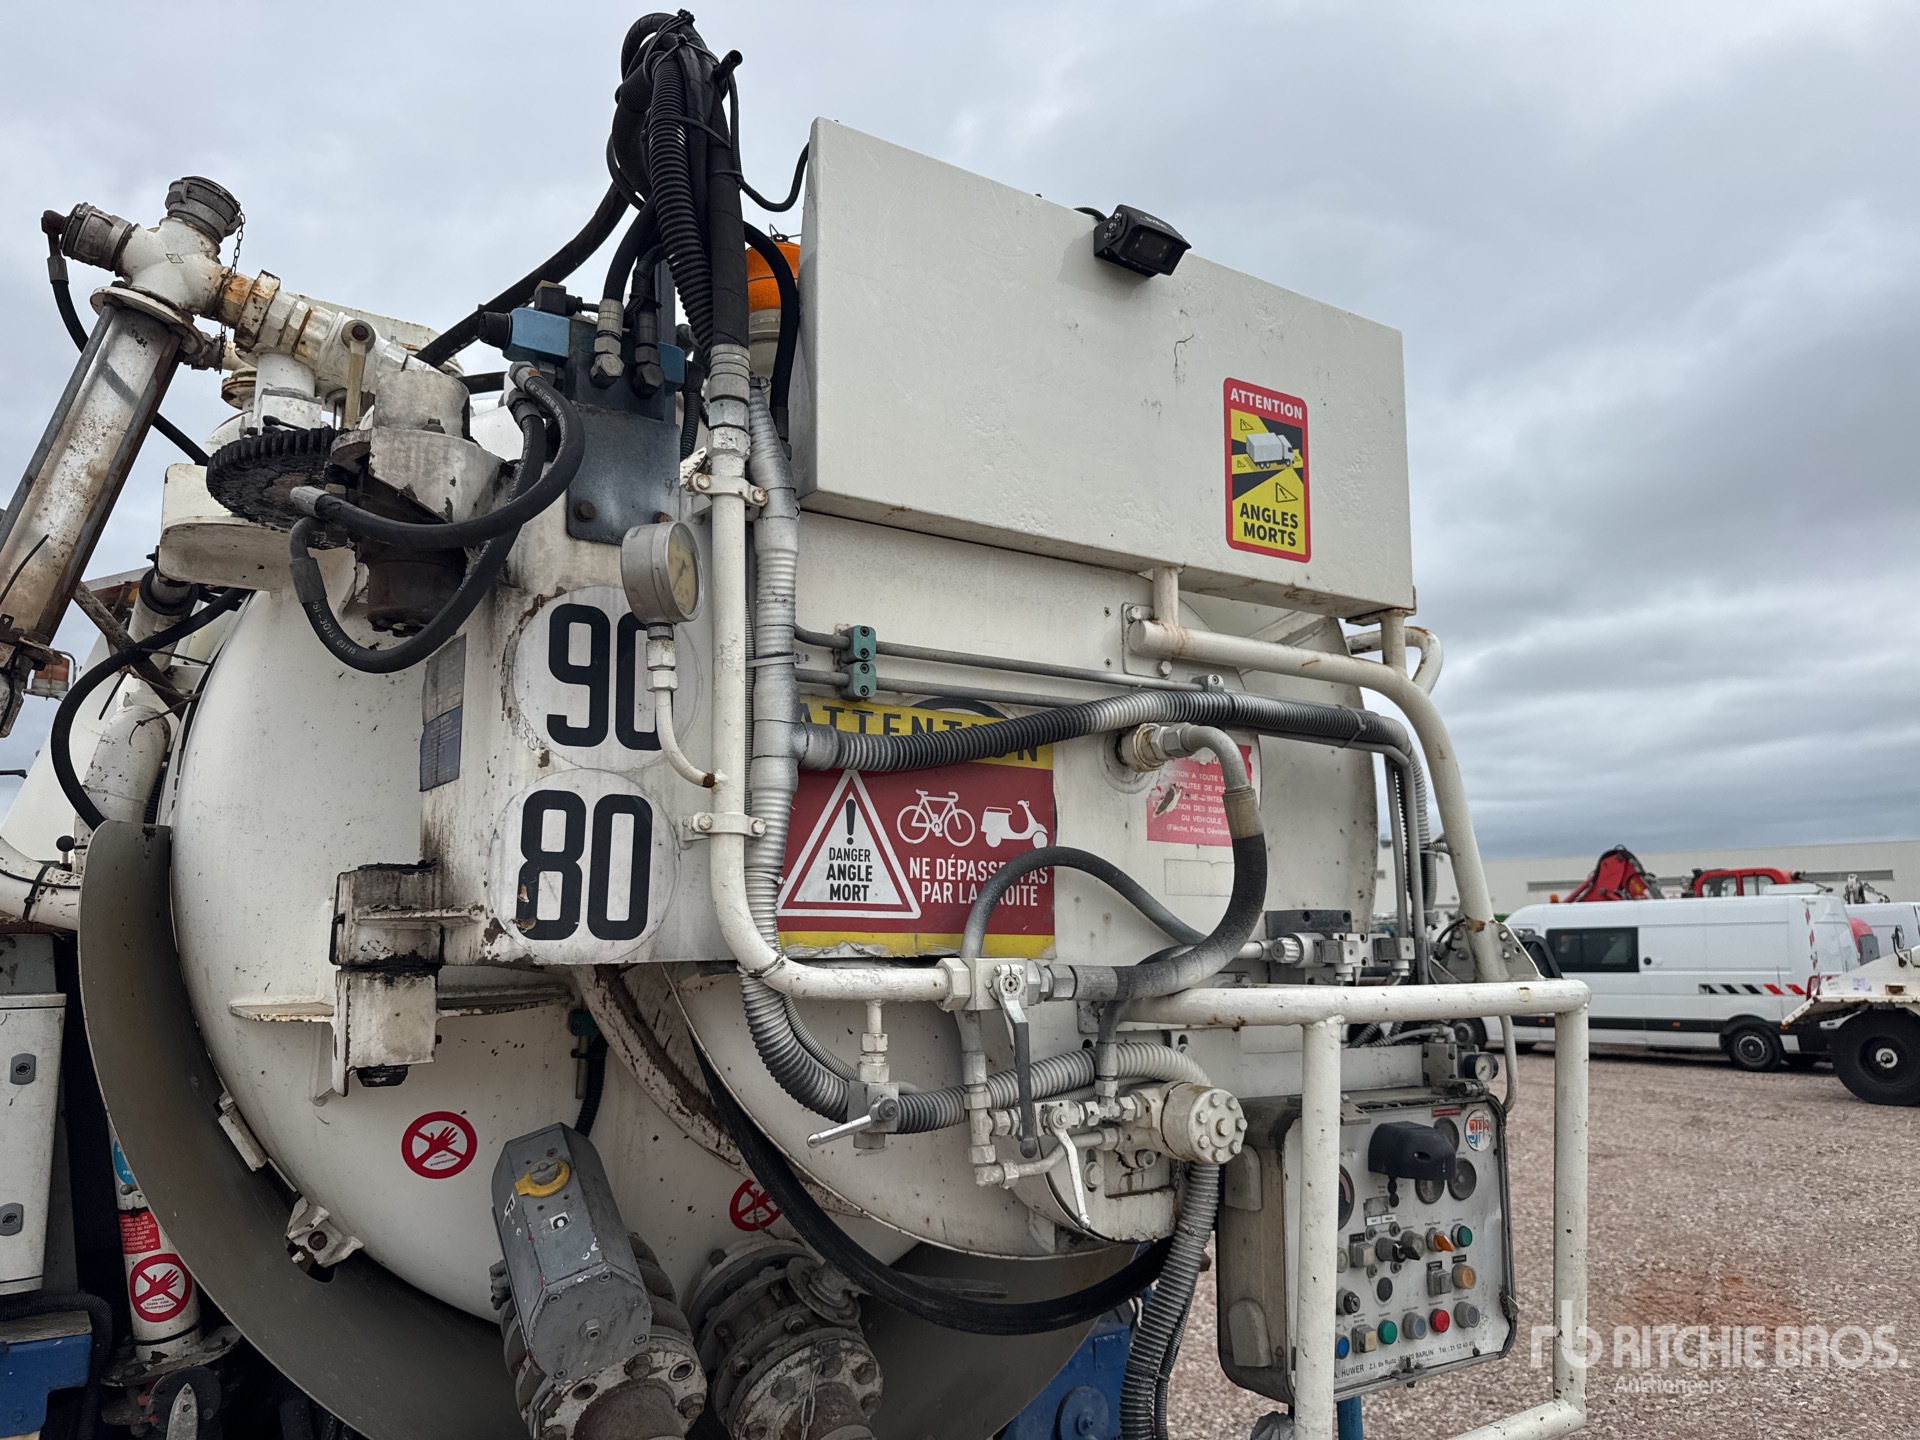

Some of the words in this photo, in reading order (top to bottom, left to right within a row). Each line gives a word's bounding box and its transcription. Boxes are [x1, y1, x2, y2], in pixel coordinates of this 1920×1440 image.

[1230, 388, 1302, 420] ATTENTION
[1240, 502, 1298, 529] ANGLES
[1244, 522, 1296, 547] MORTS
[547, 603, 673, 751] 90
[1181, 814, 1190, 822] DU
[1192, 816, 1222, 825] VEHICULE
[516, 789, 653, 941] 80
[828, 847, 871, 863] DANGER
[826, 864, 873, 883] ANGLE
[909, 856, 931, 880] NE
[829, 884, 870, 902] MORT
[921, 882, 953, 904] PAR
[958, 882, 978, 905] LA
[1341, 1364, 1365, 1378] HUWER
[1415, 1349, 1434, 1359] BARLIN
